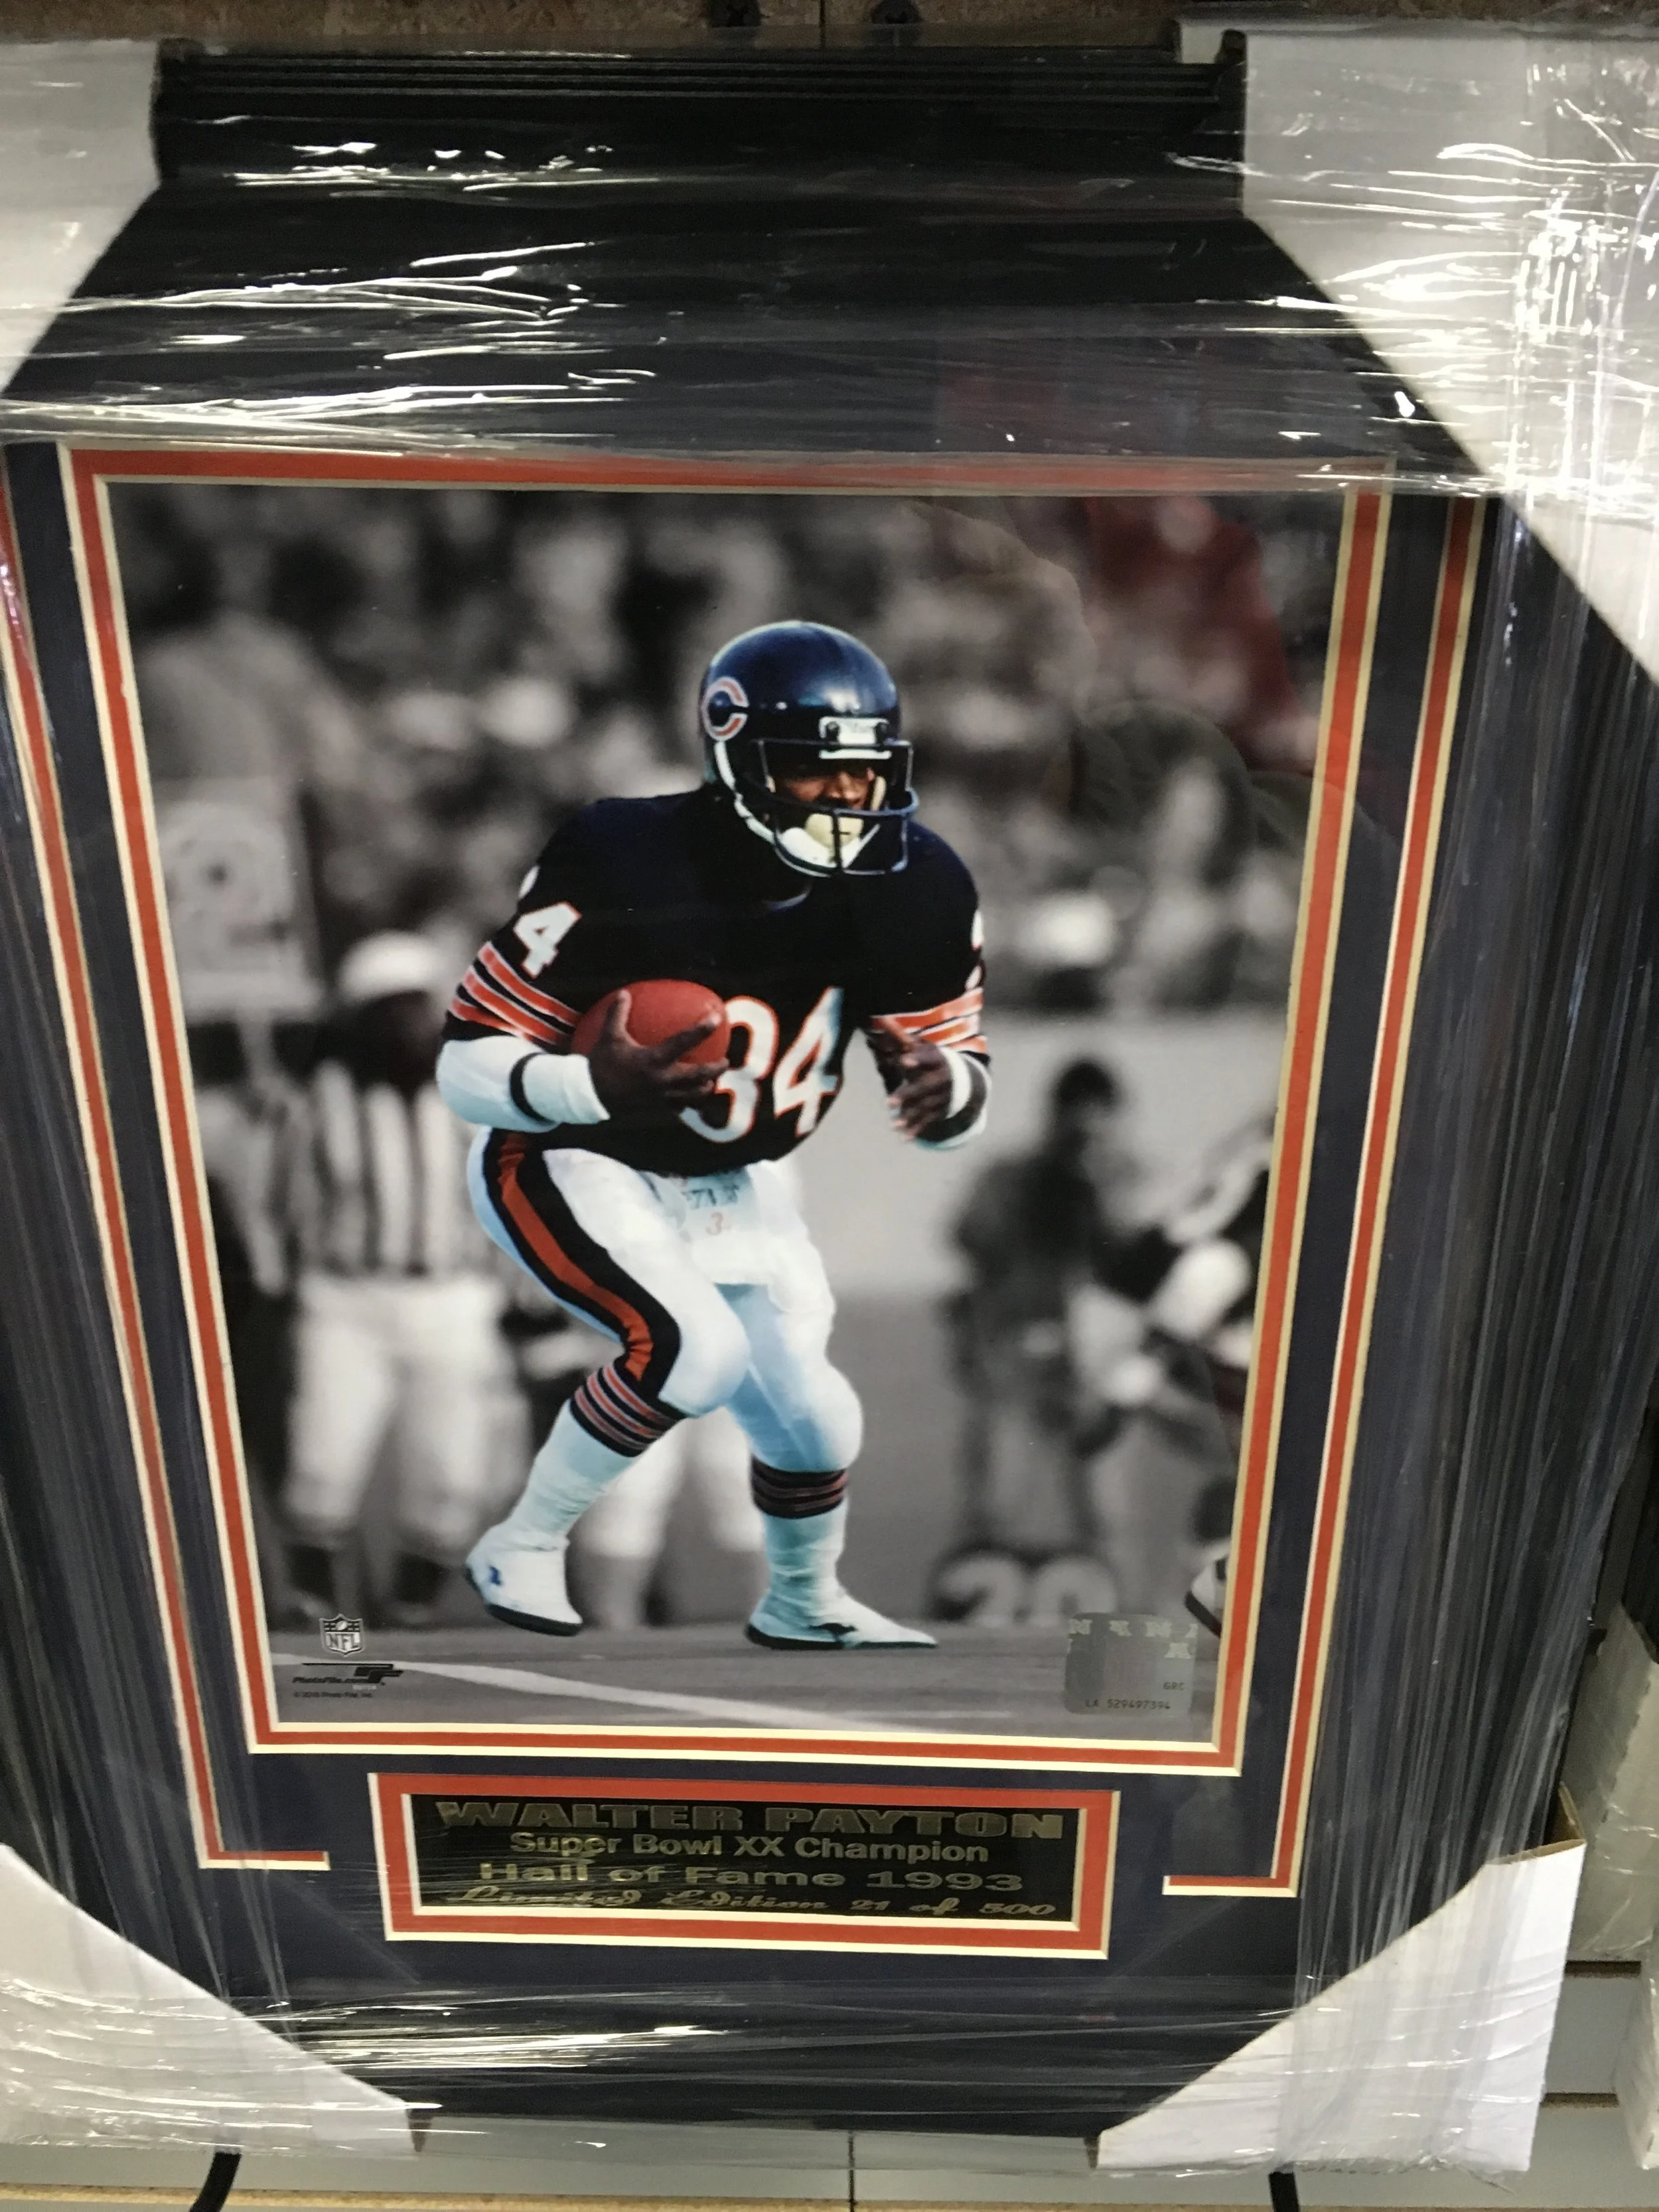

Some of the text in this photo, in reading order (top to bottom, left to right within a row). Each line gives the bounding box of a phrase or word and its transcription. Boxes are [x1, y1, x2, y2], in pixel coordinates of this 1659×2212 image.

[679, 986, 844, 1143] 34
[435, 1801, 1064, 1839] WALTER PAYTON
[510, 1831, 990, 1865] Super Bowl XX Champion
[479, 1862, 1023, 1891] Hall of Fame 1993
[660, 1889, 830, 1909] Edition
[849, 1899, 891, 1911] 21
[909, 1897, 961, 1915] of
[978, 1902, 1056, 1916] 500
